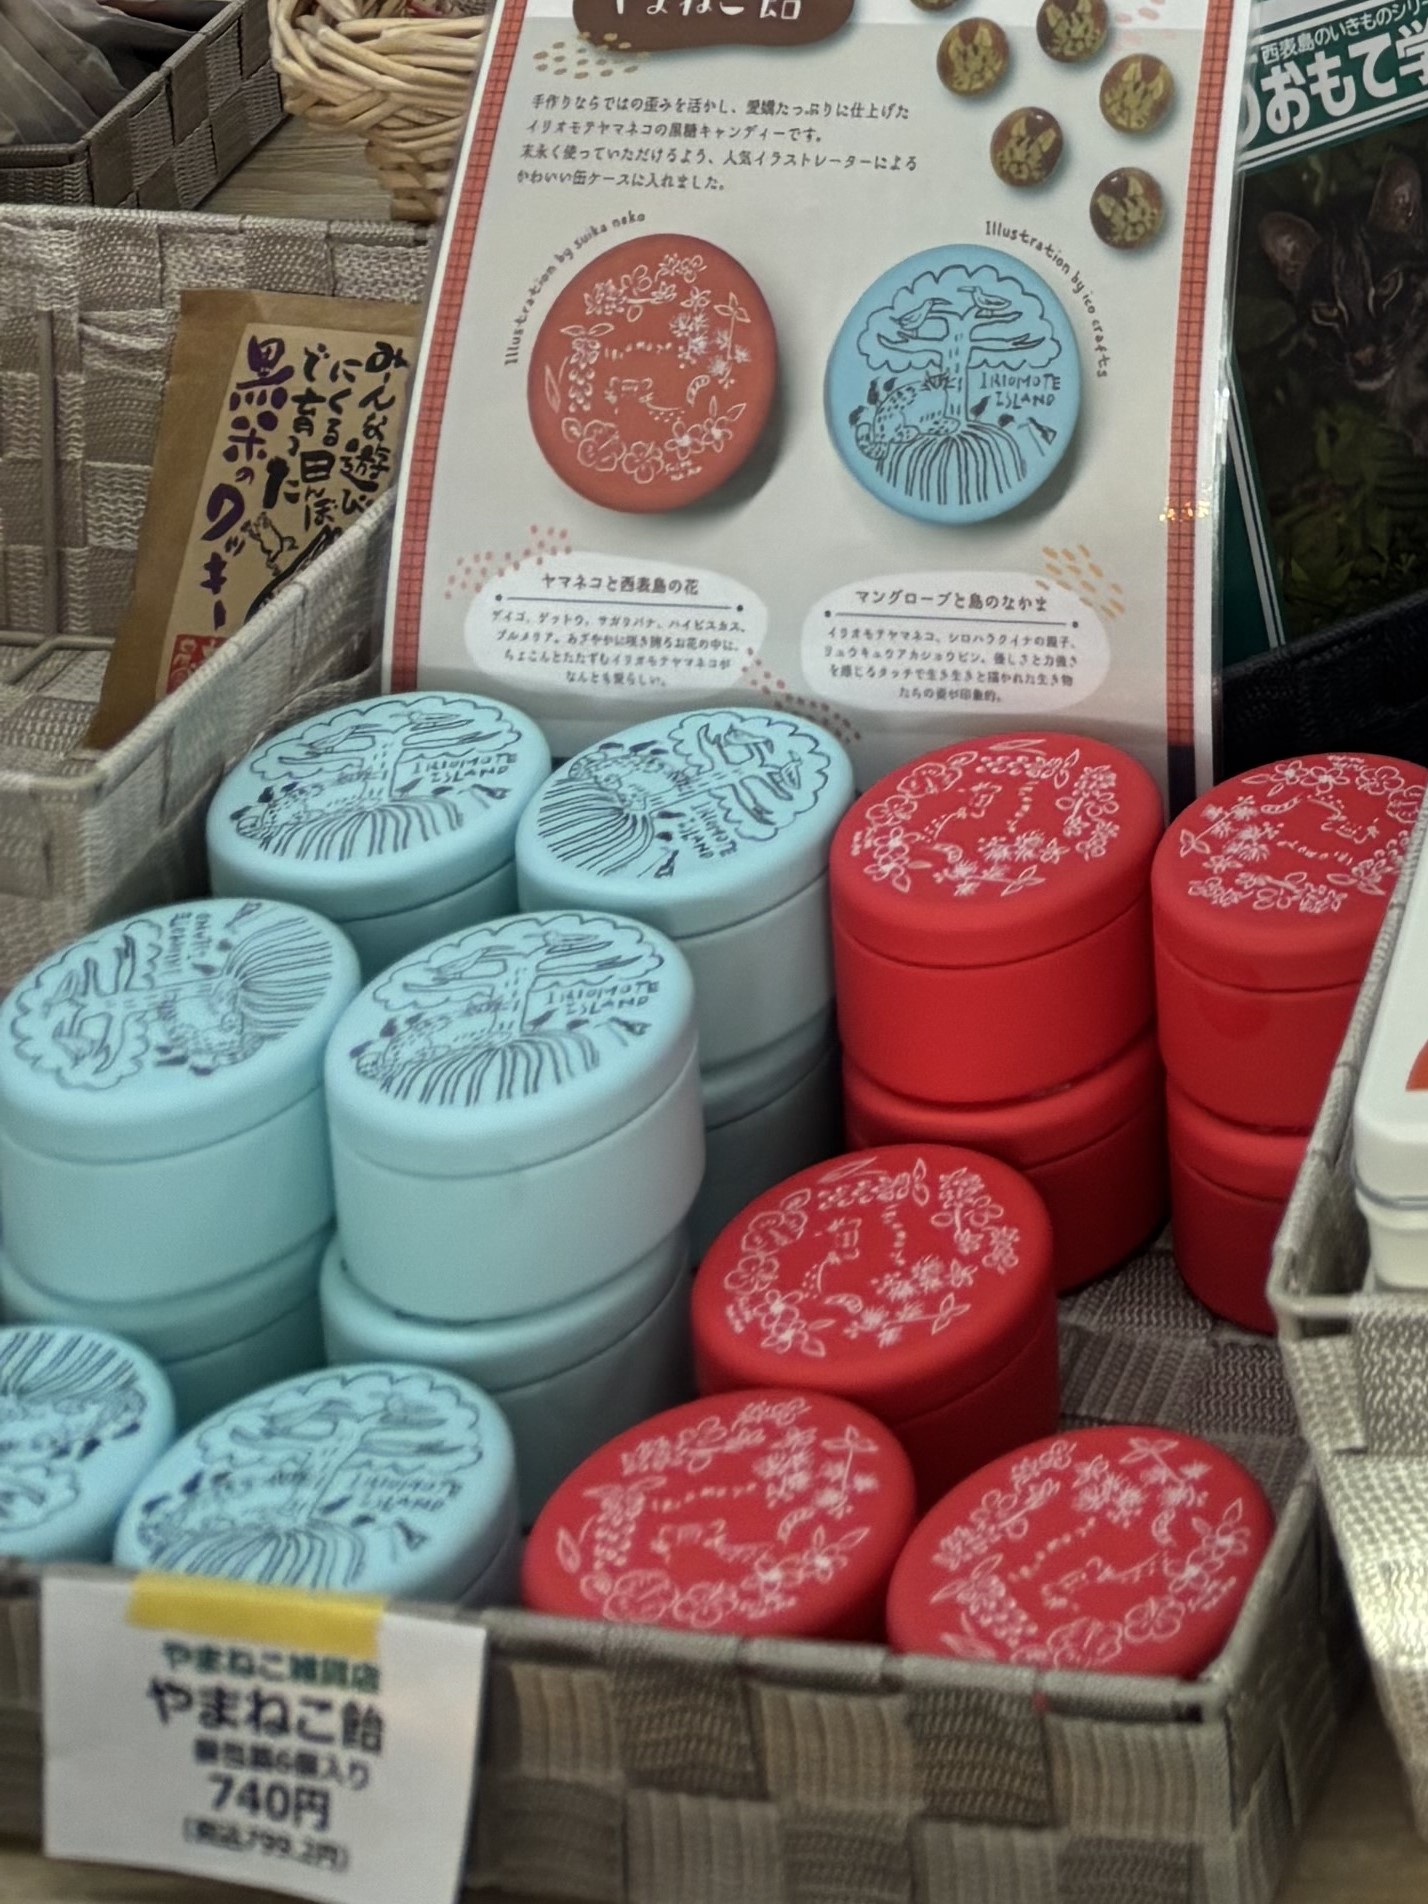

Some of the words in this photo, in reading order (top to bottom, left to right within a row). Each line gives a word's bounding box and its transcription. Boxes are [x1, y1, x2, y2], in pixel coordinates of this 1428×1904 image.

[541, 572, 700, 595] ヤマネコと西表島の花
[855, 589, 1049, 613] マングローブと島のなかま
[147, 1676, 385, 1754] やまねこ飴
[208, 1772, 332, 1834] 740円
